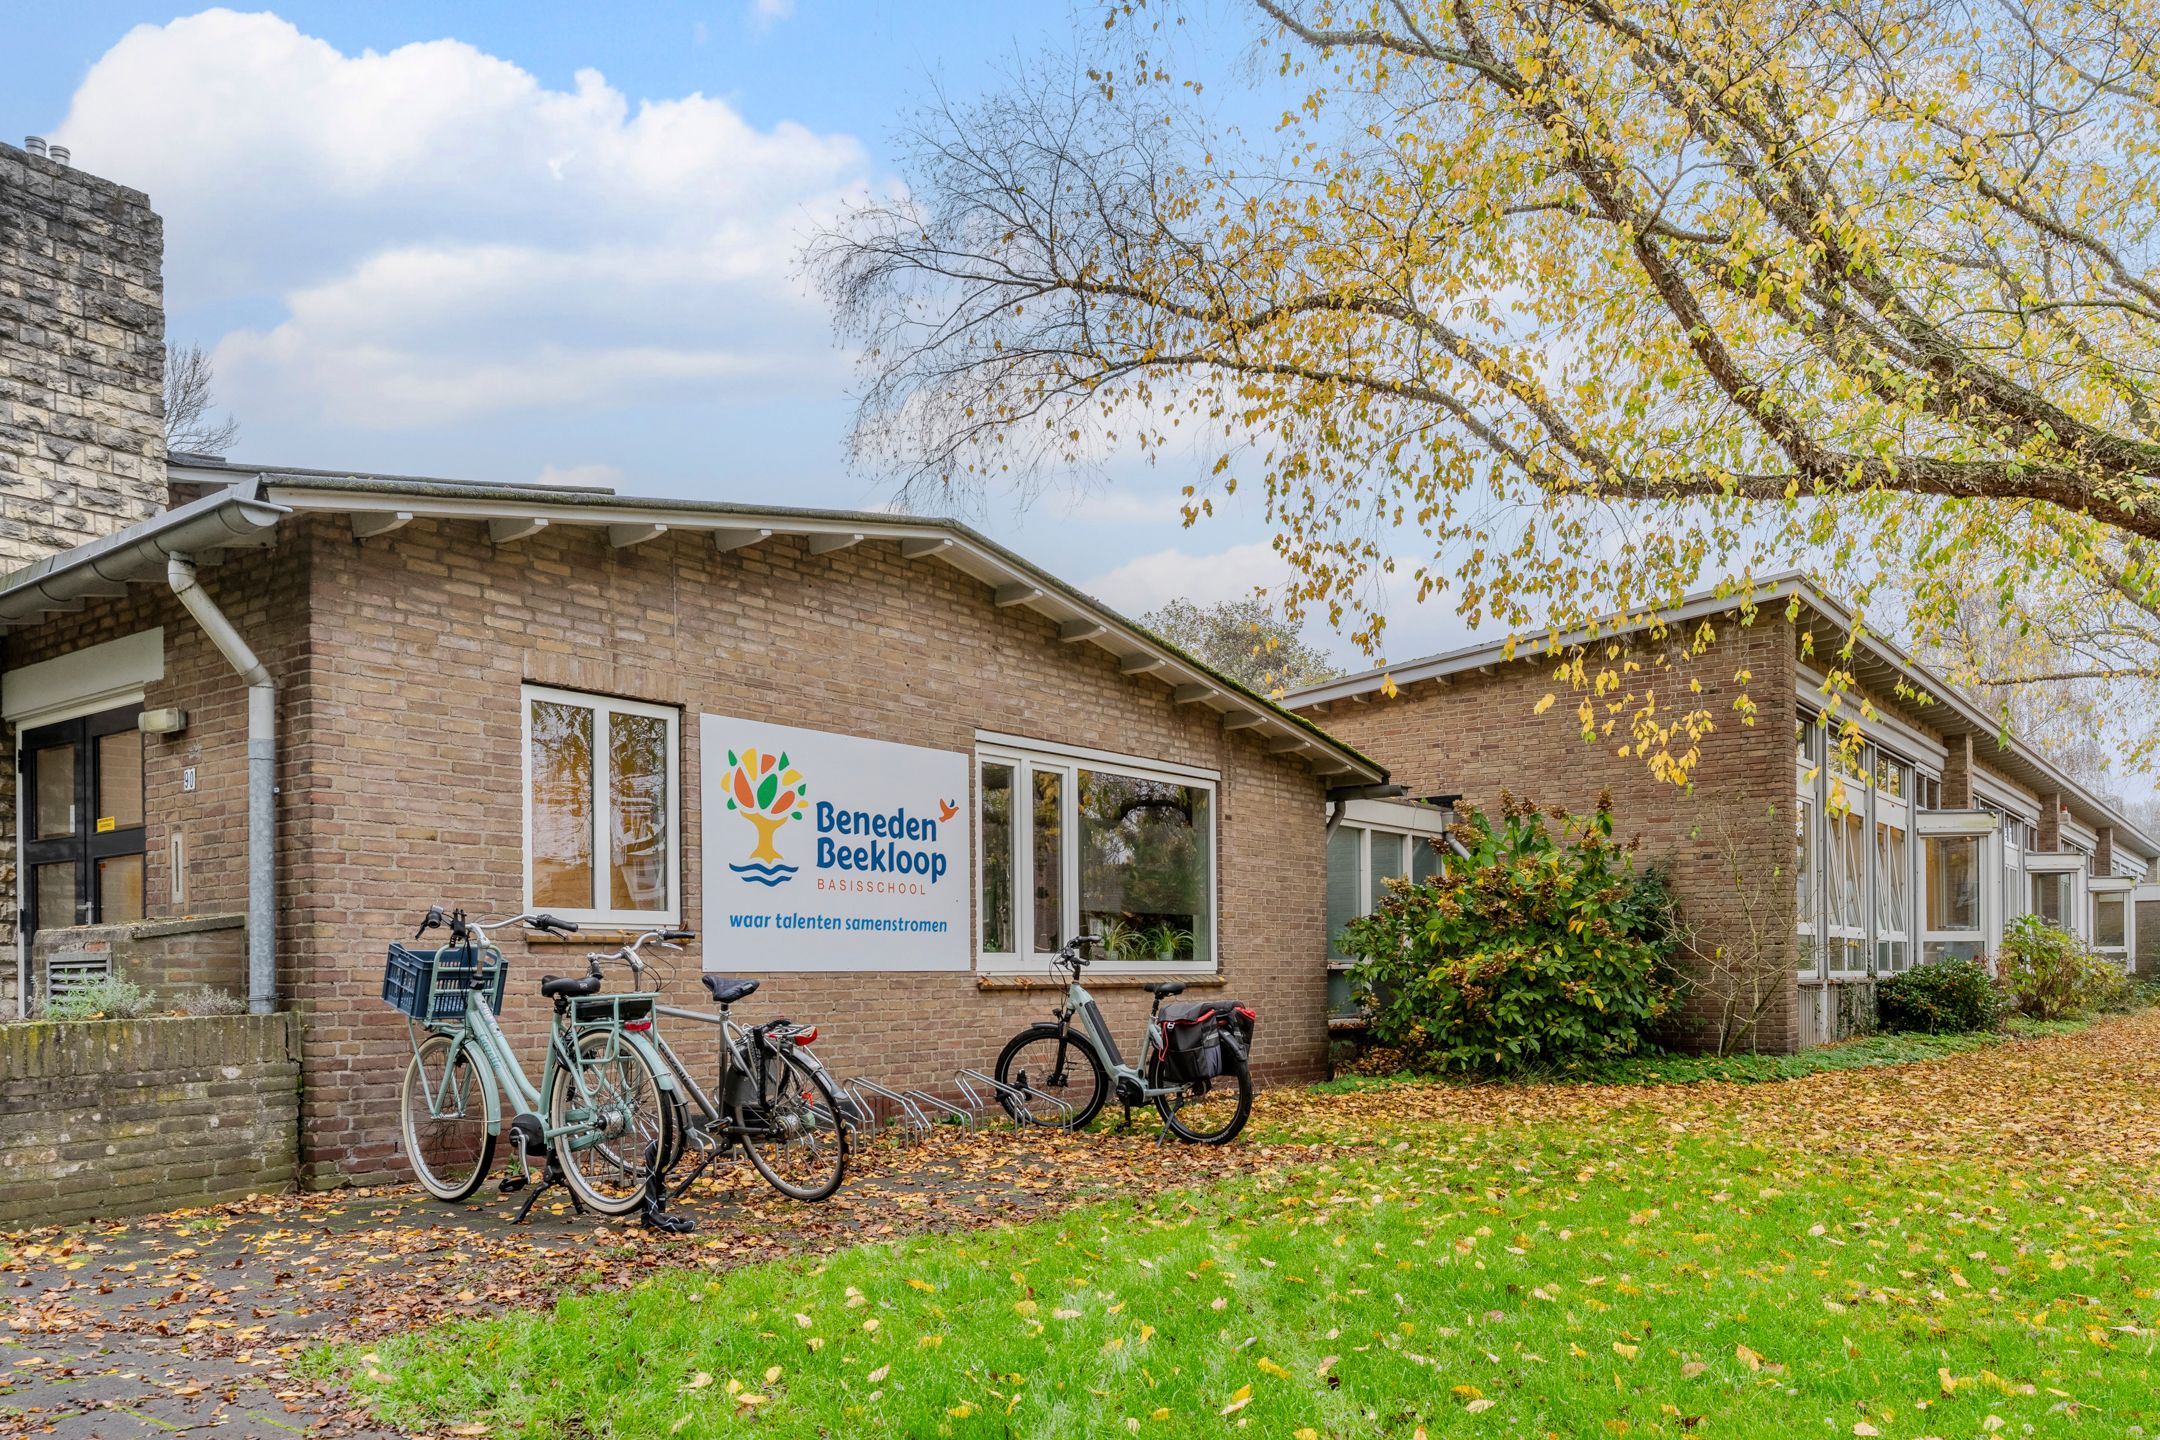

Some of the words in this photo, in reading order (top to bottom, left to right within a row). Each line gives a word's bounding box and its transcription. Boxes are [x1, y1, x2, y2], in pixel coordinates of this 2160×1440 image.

[184, 771, 194, 788] 90
[816, 801, 937, 842] Beneden
[816, 836, 947, 884] Beekloop
[817, 878, 926, 895] BASISSCHOOL
[729, 913, 771, 928] waar
[775, 912, 841, 930] talenten
[845, 916, 948, 933] samenstromen
